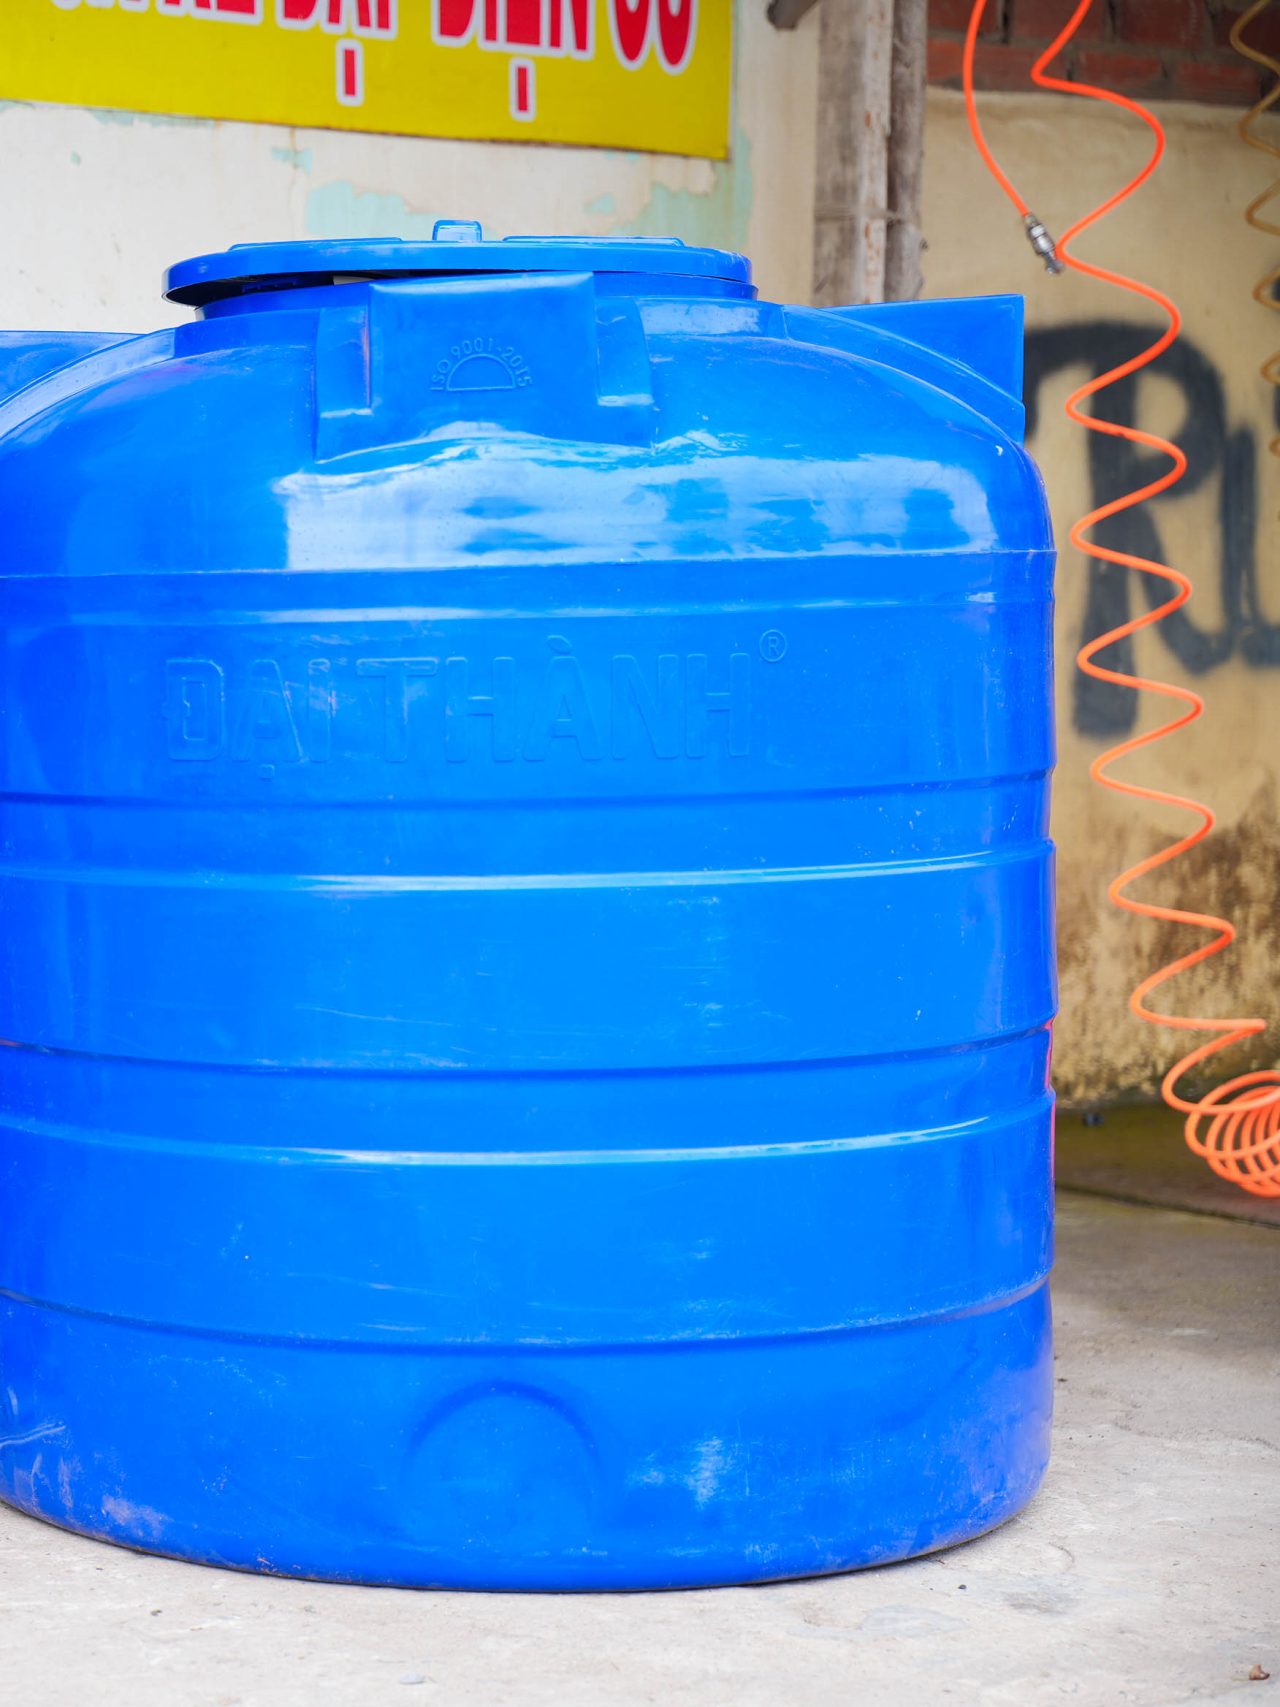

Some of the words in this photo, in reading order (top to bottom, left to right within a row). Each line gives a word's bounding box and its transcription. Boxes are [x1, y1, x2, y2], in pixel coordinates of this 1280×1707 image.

[429, 359, 452, 391] ISO
[162, 657, 332, 780] ĐẠI
[356, 634, 751, 764] THÀNH
